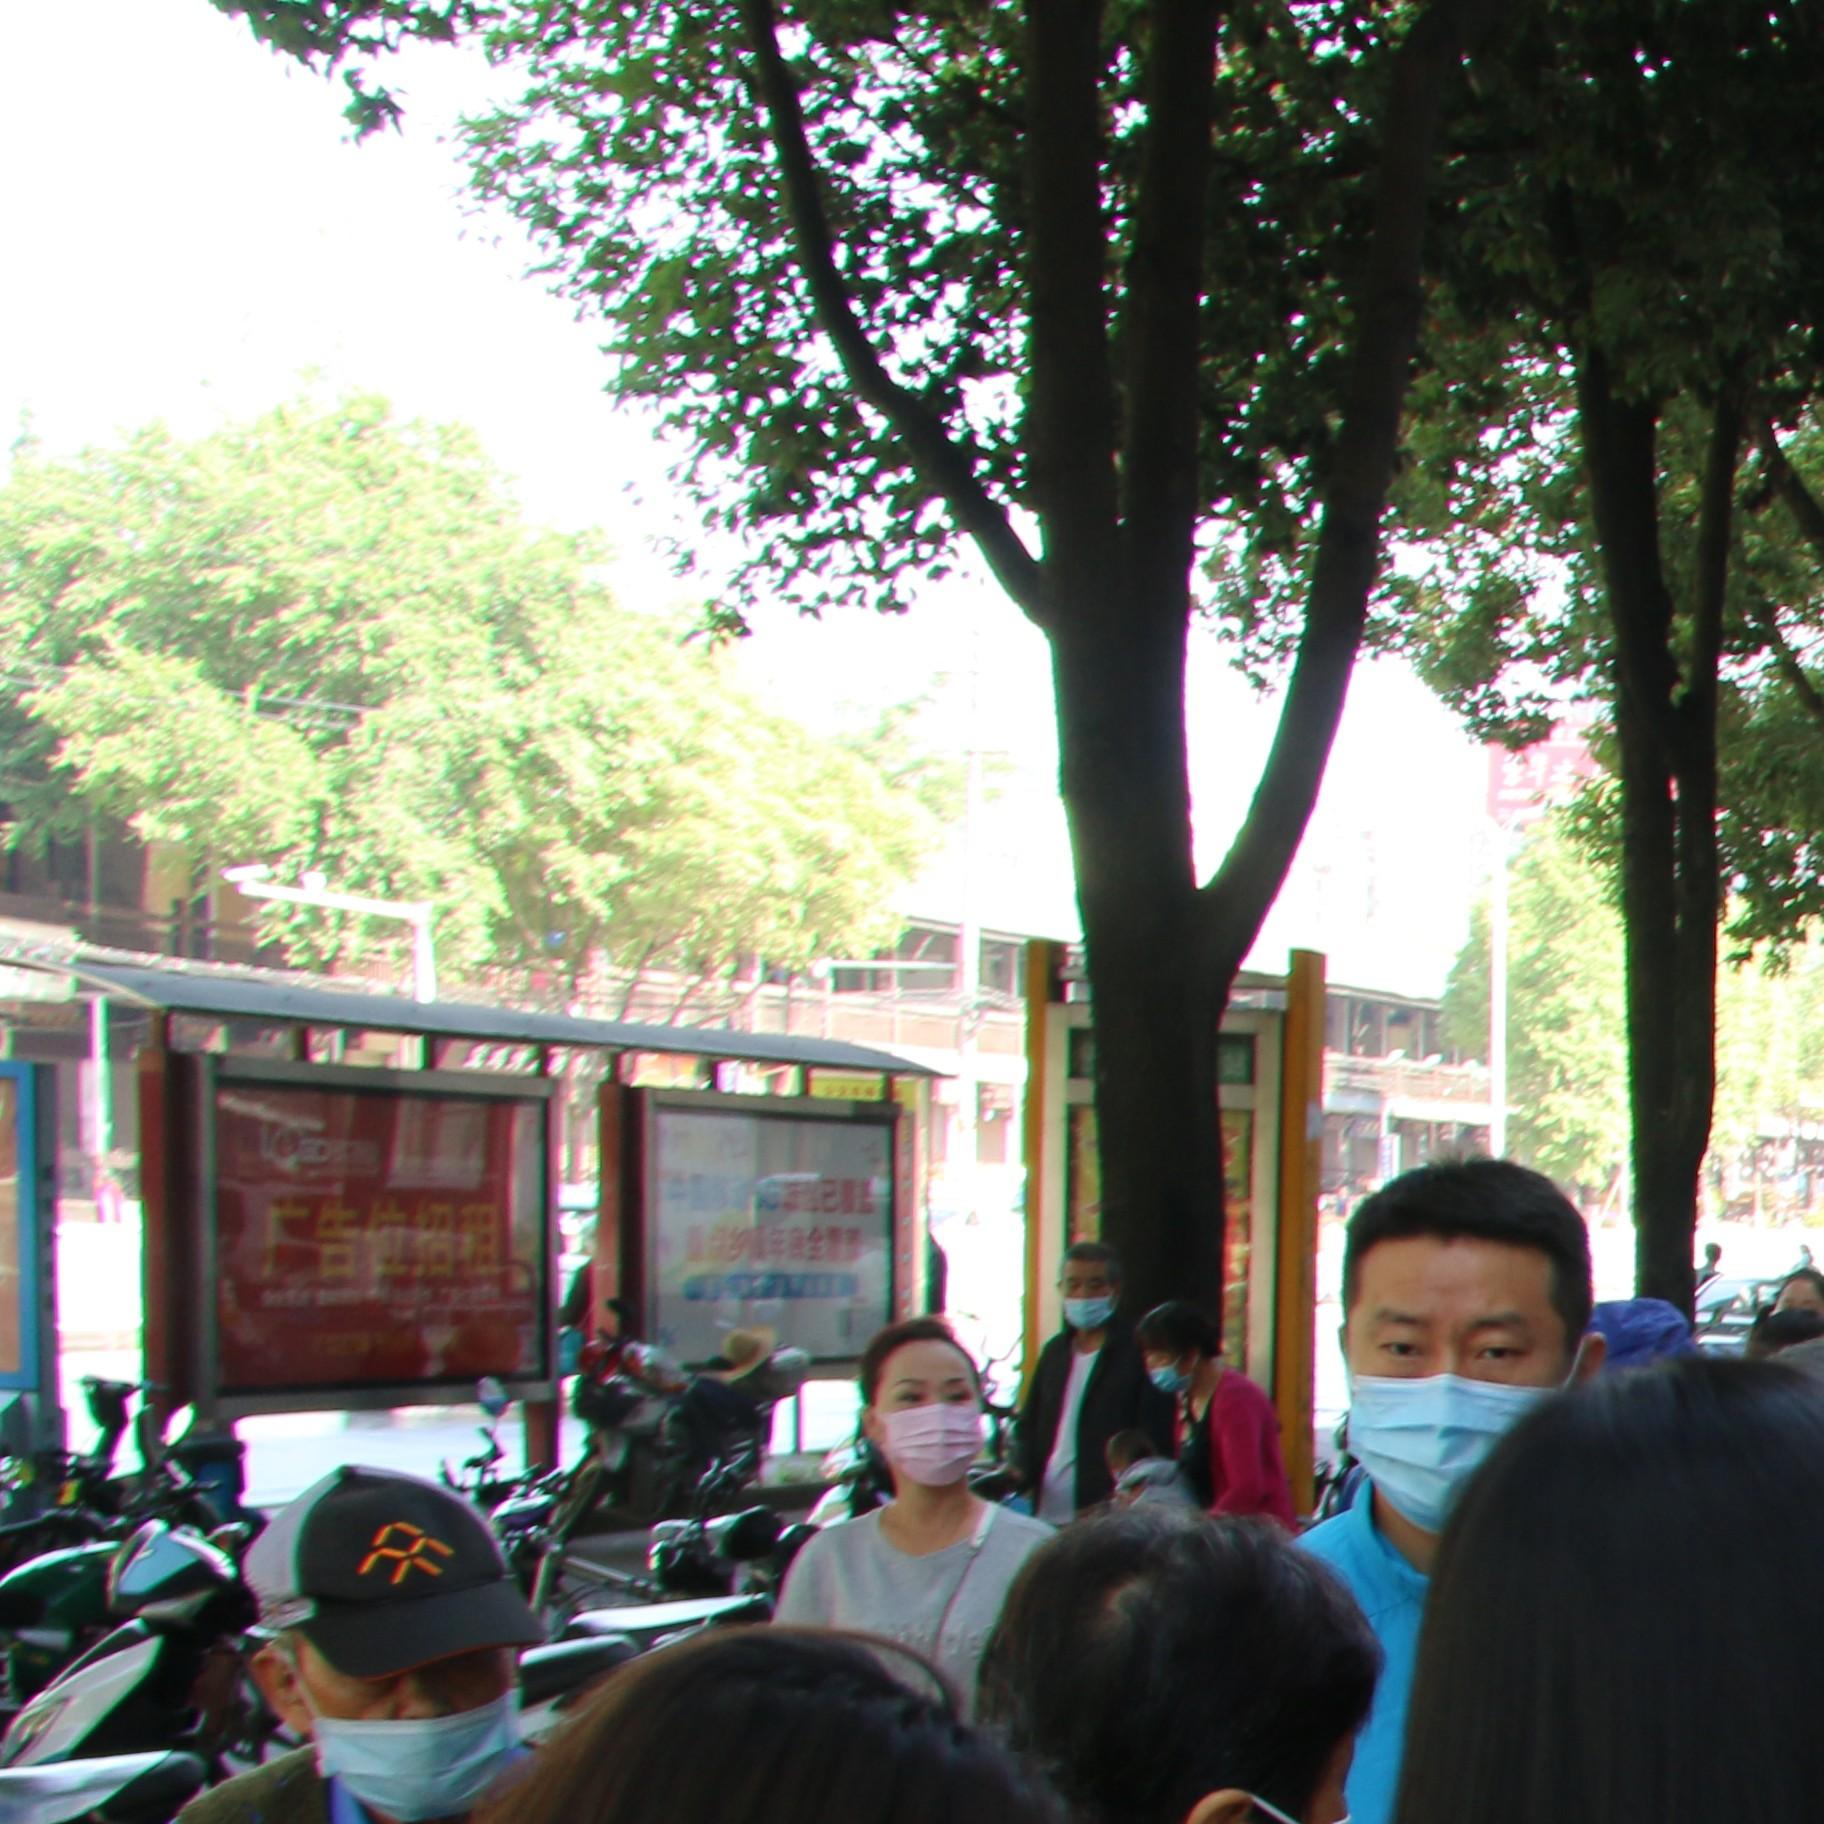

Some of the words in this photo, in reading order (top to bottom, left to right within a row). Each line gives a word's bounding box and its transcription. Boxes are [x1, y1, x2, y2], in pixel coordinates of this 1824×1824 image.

[262, 1197, 500, 1279] 广告位招租
